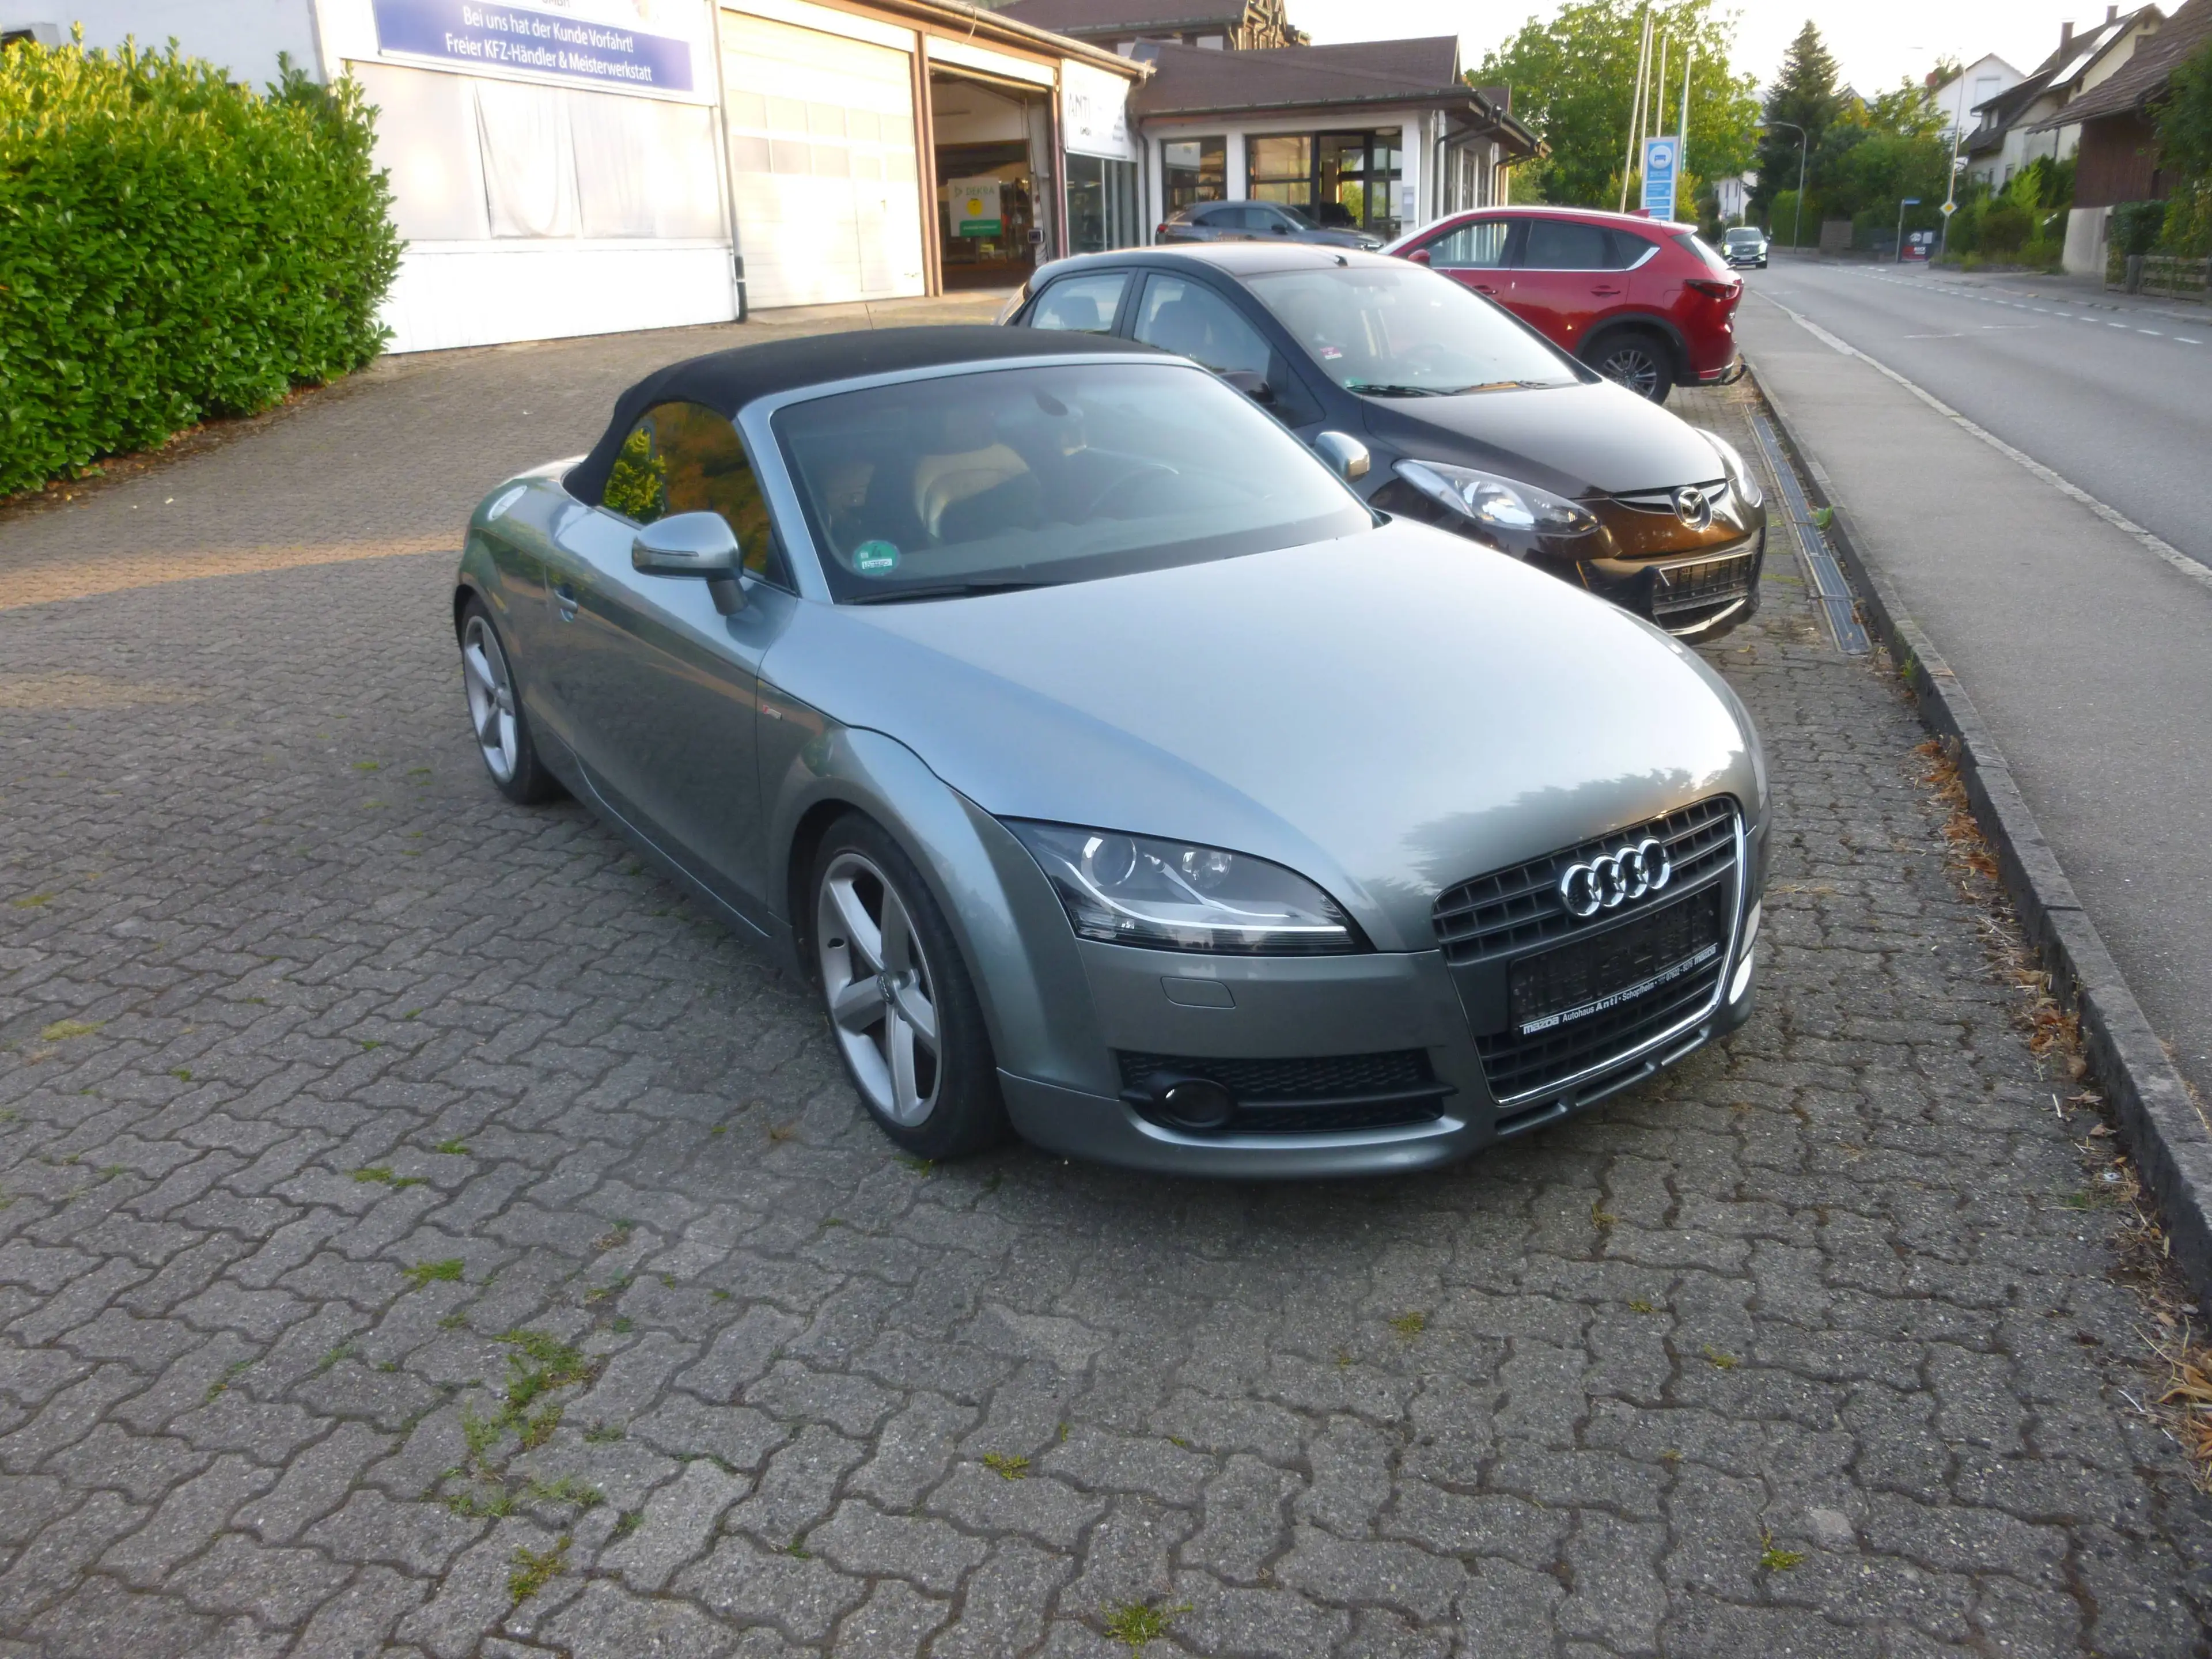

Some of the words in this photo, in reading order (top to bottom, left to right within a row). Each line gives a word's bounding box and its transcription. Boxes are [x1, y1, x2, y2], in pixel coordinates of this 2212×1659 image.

[463, 5, 483, 28] Bei
[486, 14, 508, 32] uns
[510, 14, 530, 35] hat
[532, 18, 551, 38] der
[553, 22, 588, 45] Kunde
[588, 28, 634, 54] Vorfahrt!
[445, 32, 482, 56] Freier
[484, 39, 556, 67] KFZ-Händler
[559, 50, 567, 70] &
[569, 52, 652, 81] Meisterwerkstatt
[1068, 92, 1090, 120] ANTI
[966, 185, 995, 196] DEKRA
[1523, 1016, 1559, 1035] mazda
[1562, 1006, 1594, 1022] Autohaus
[1596, 995, 1618, 1012] Anti
[1622, 980, 1654, 1001] Schopfheim
[1694, 946, 1716, 965] mazda
